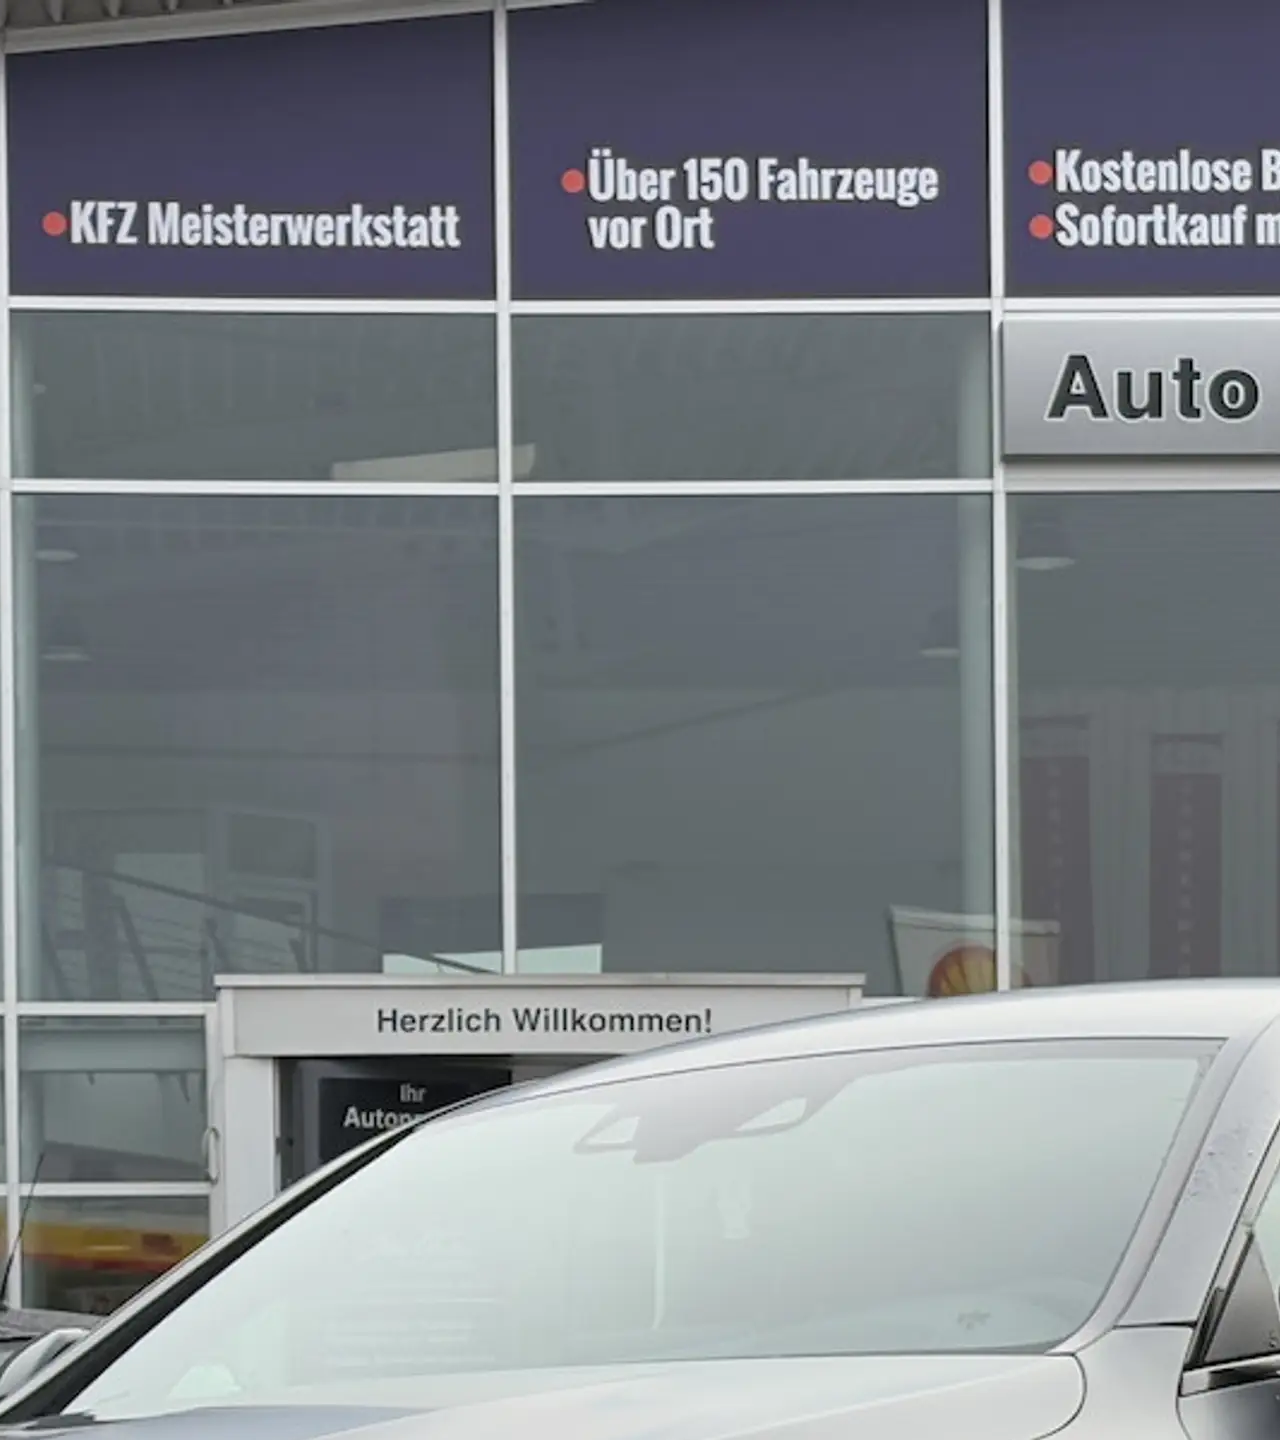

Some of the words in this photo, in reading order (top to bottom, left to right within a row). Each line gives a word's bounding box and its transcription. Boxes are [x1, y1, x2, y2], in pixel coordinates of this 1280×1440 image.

[590, 148, 676, 202] Über
[684, 157, 748, 202] 150
[758, 157, 938, 207] Fahrzeuge
[1057, 149, 1252, 193] Kostenlose
[72, 201, 137, 245] KFZ
[149, 201, 461, 248] Meisterwerkstatt
[589, 217, 647, 250] vor
[656, 206, 714, 250] Ort
[1056, 204, 1247, 247] Sofortkauf
[1049, 356, 1258, 420] Auto
[377, 1007, 501, 1033] Herzlich
[512, 1007, 712, 1034] Willkommen!
[400, 1083, 426, 1103] Ihr
